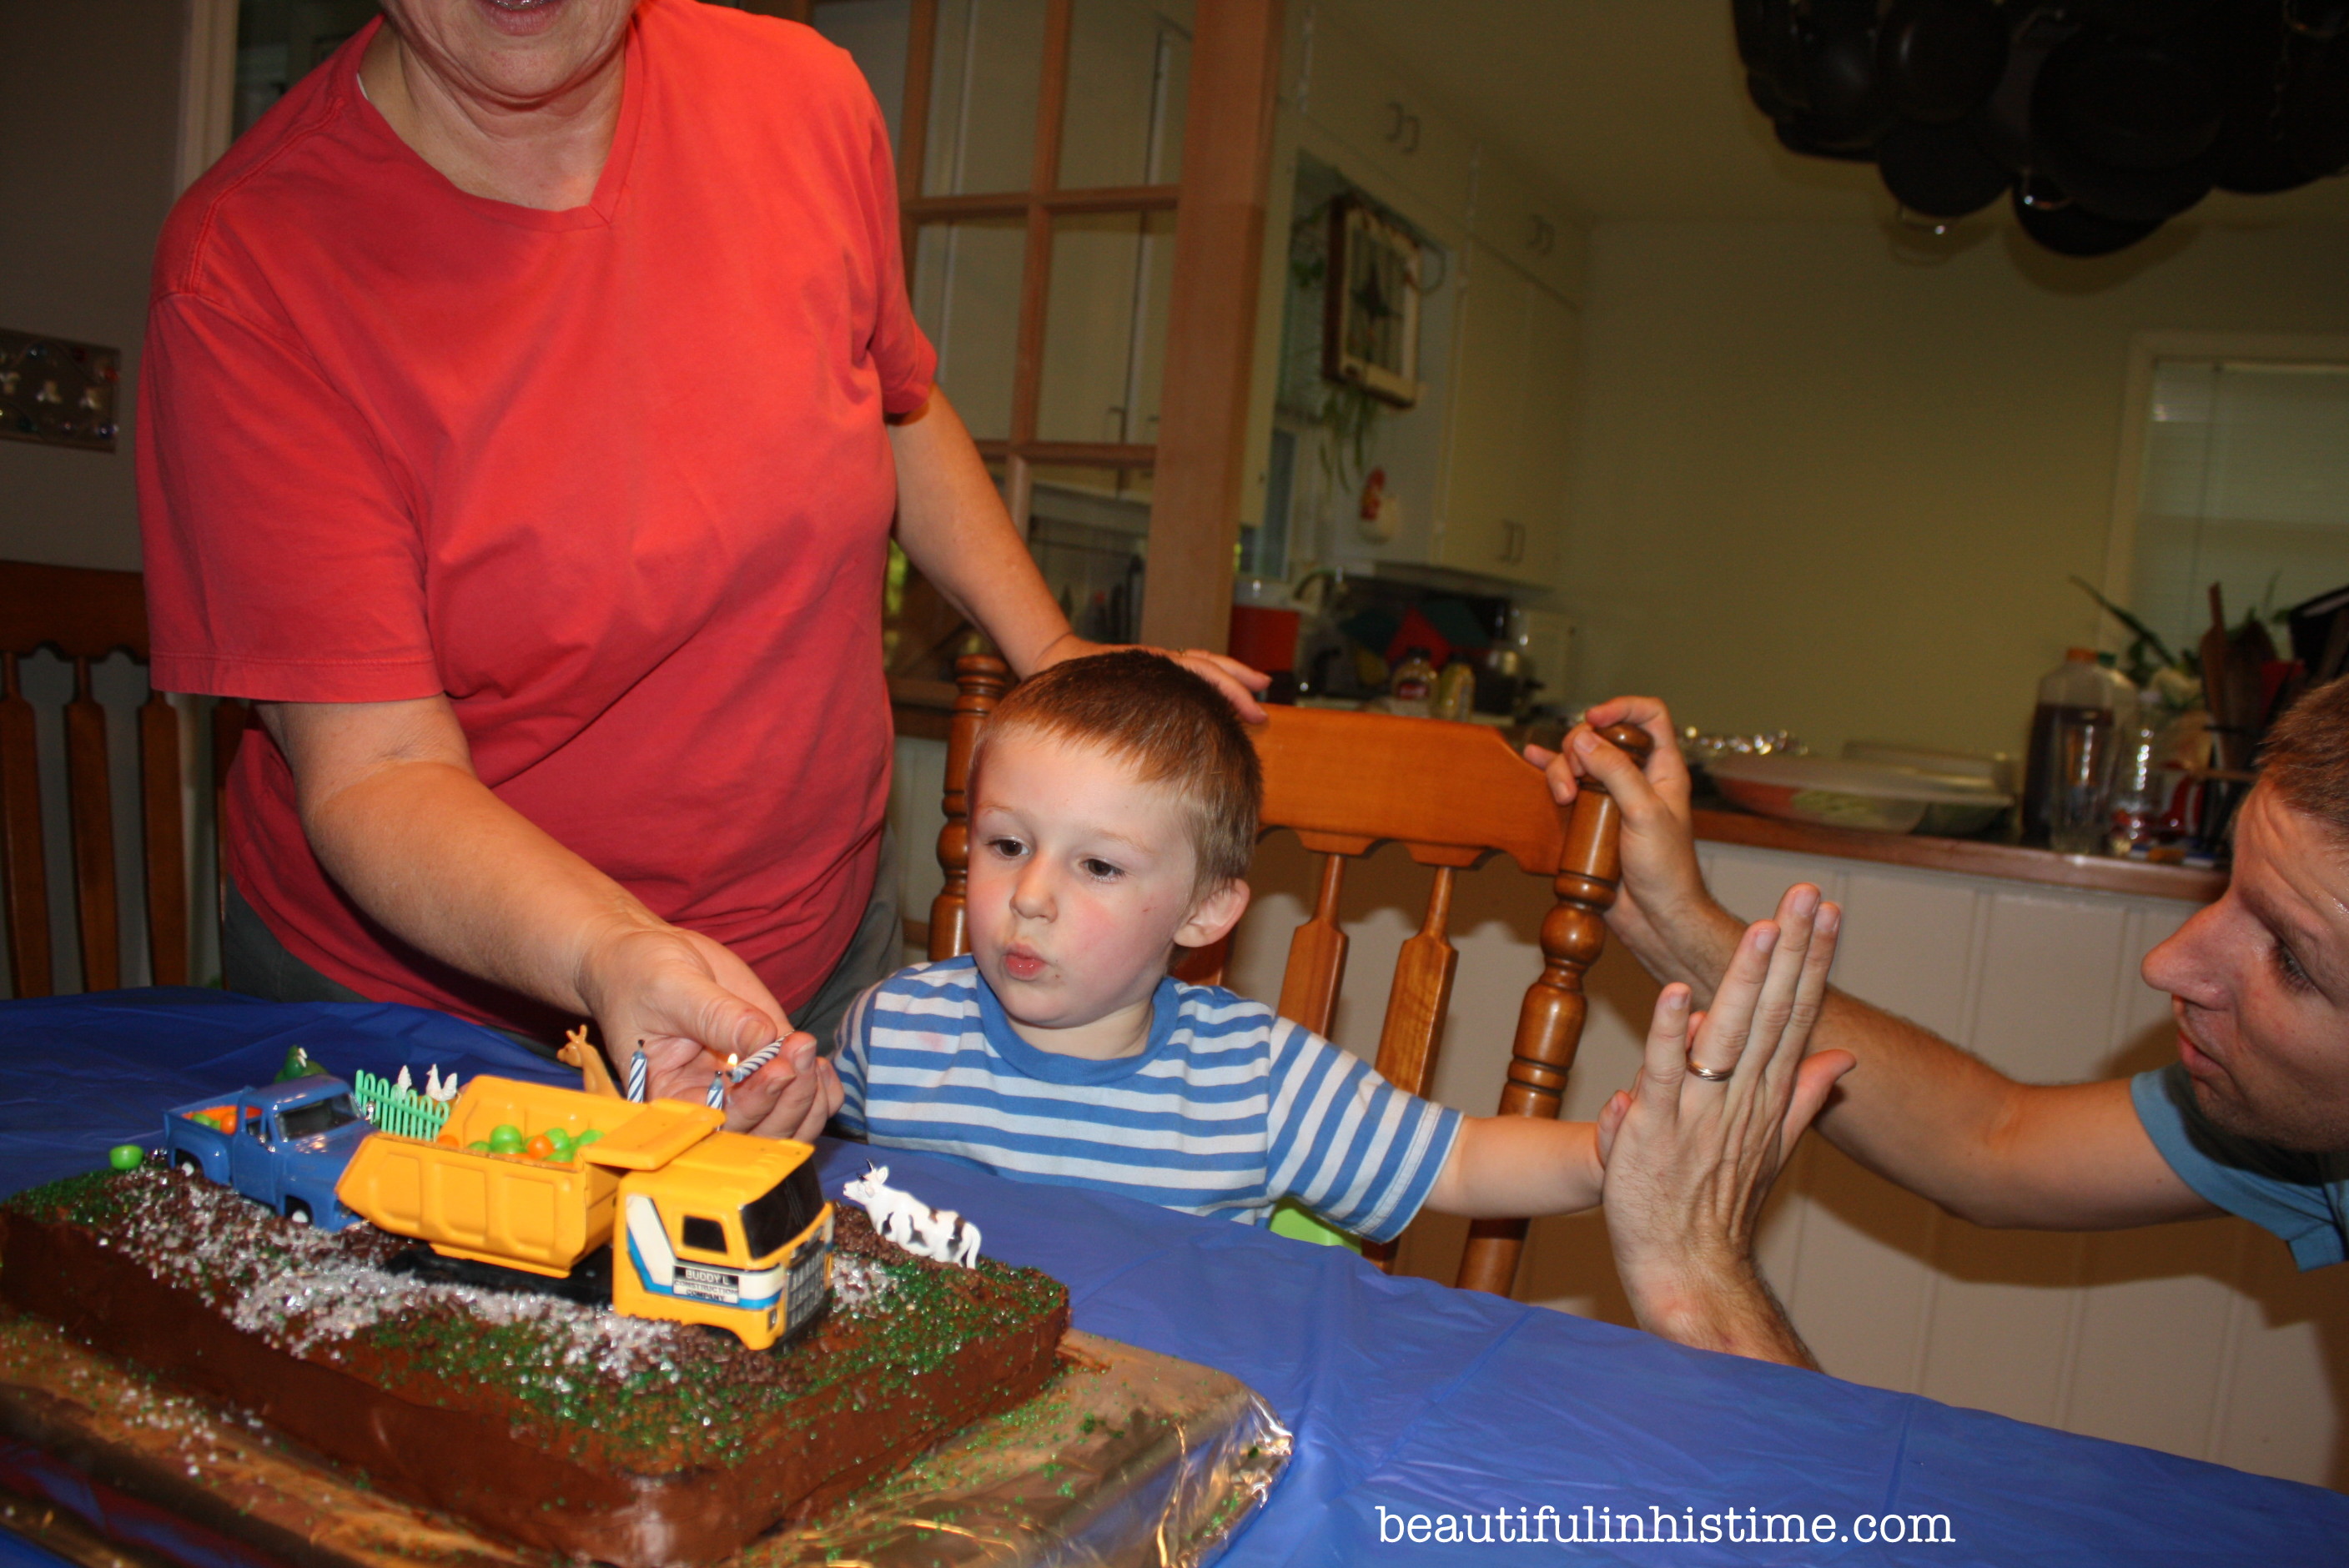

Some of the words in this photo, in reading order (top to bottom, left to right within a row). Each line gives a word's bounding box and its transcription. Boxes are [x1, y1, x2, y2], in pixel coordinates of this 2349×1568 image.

[685, 1269, 720, 1284] BUDDY
[722, 1275, 730, 1286] L
[674, 1279, 738, 1295] CONSTRUCTION
[686, 1289, 726, 1302] COMPANY
